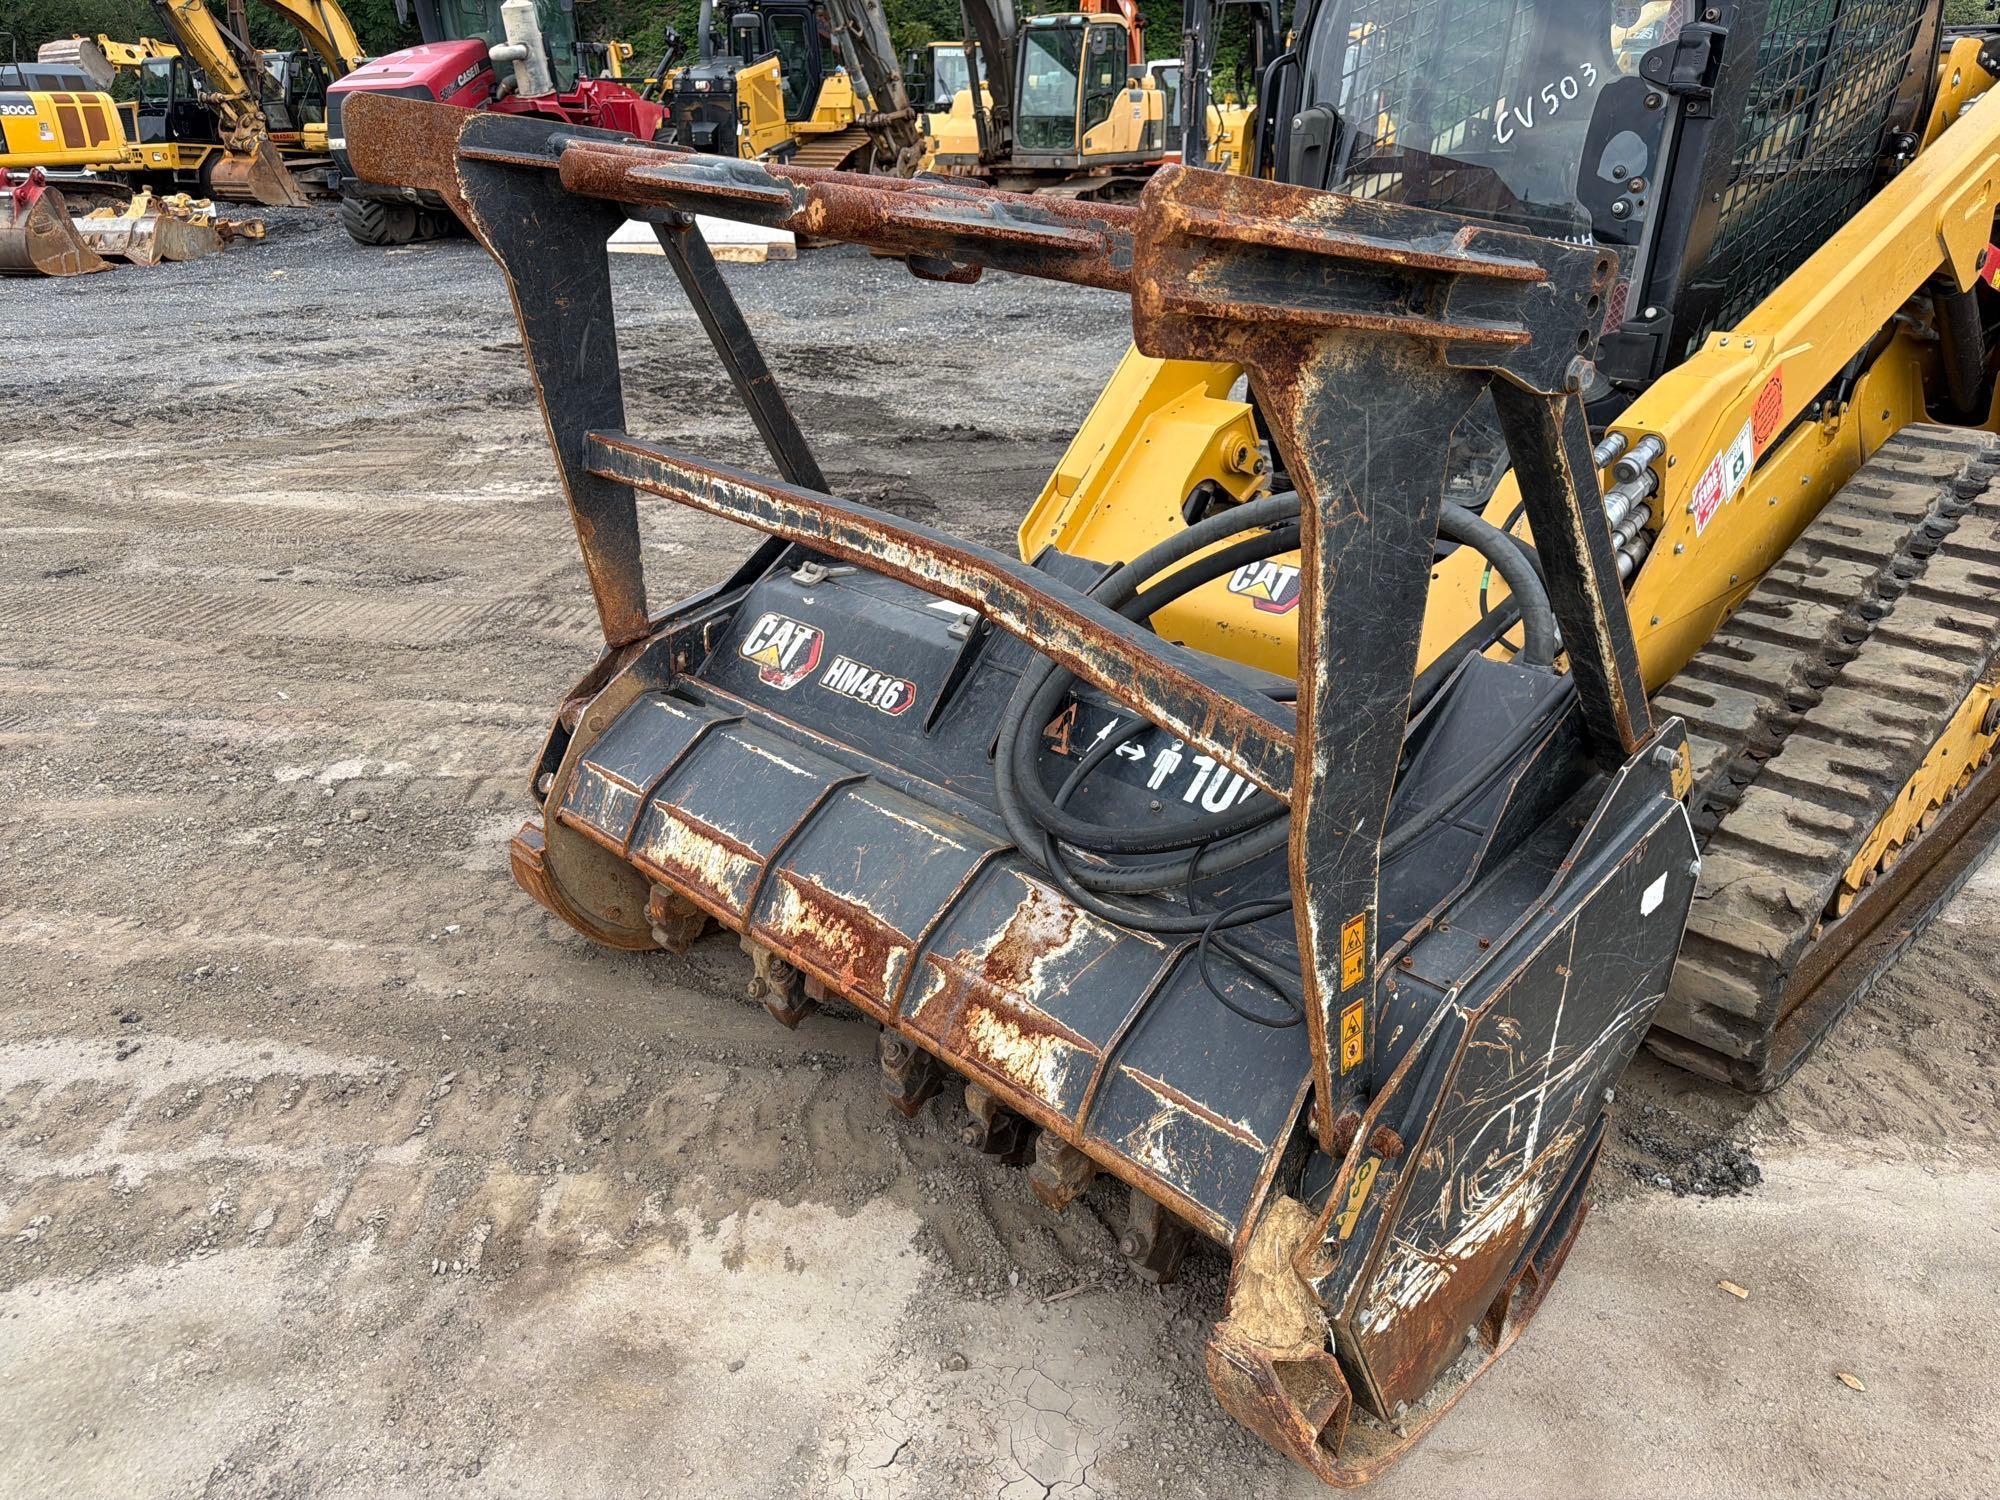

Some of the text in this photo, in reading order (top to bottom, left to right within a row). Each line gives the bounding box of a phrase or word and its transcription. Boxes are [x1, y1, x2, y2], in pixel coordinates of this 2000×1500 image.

[0, 105, 35, 115] 300G
[1698, 466, 1719, 508] FIRE
[1229, 561, 1300, 602] CAT
[742, 613, 816, 671] CAT
[821, 658, 904, 710] HM416
[1183, 755, 1258, 813] 10
